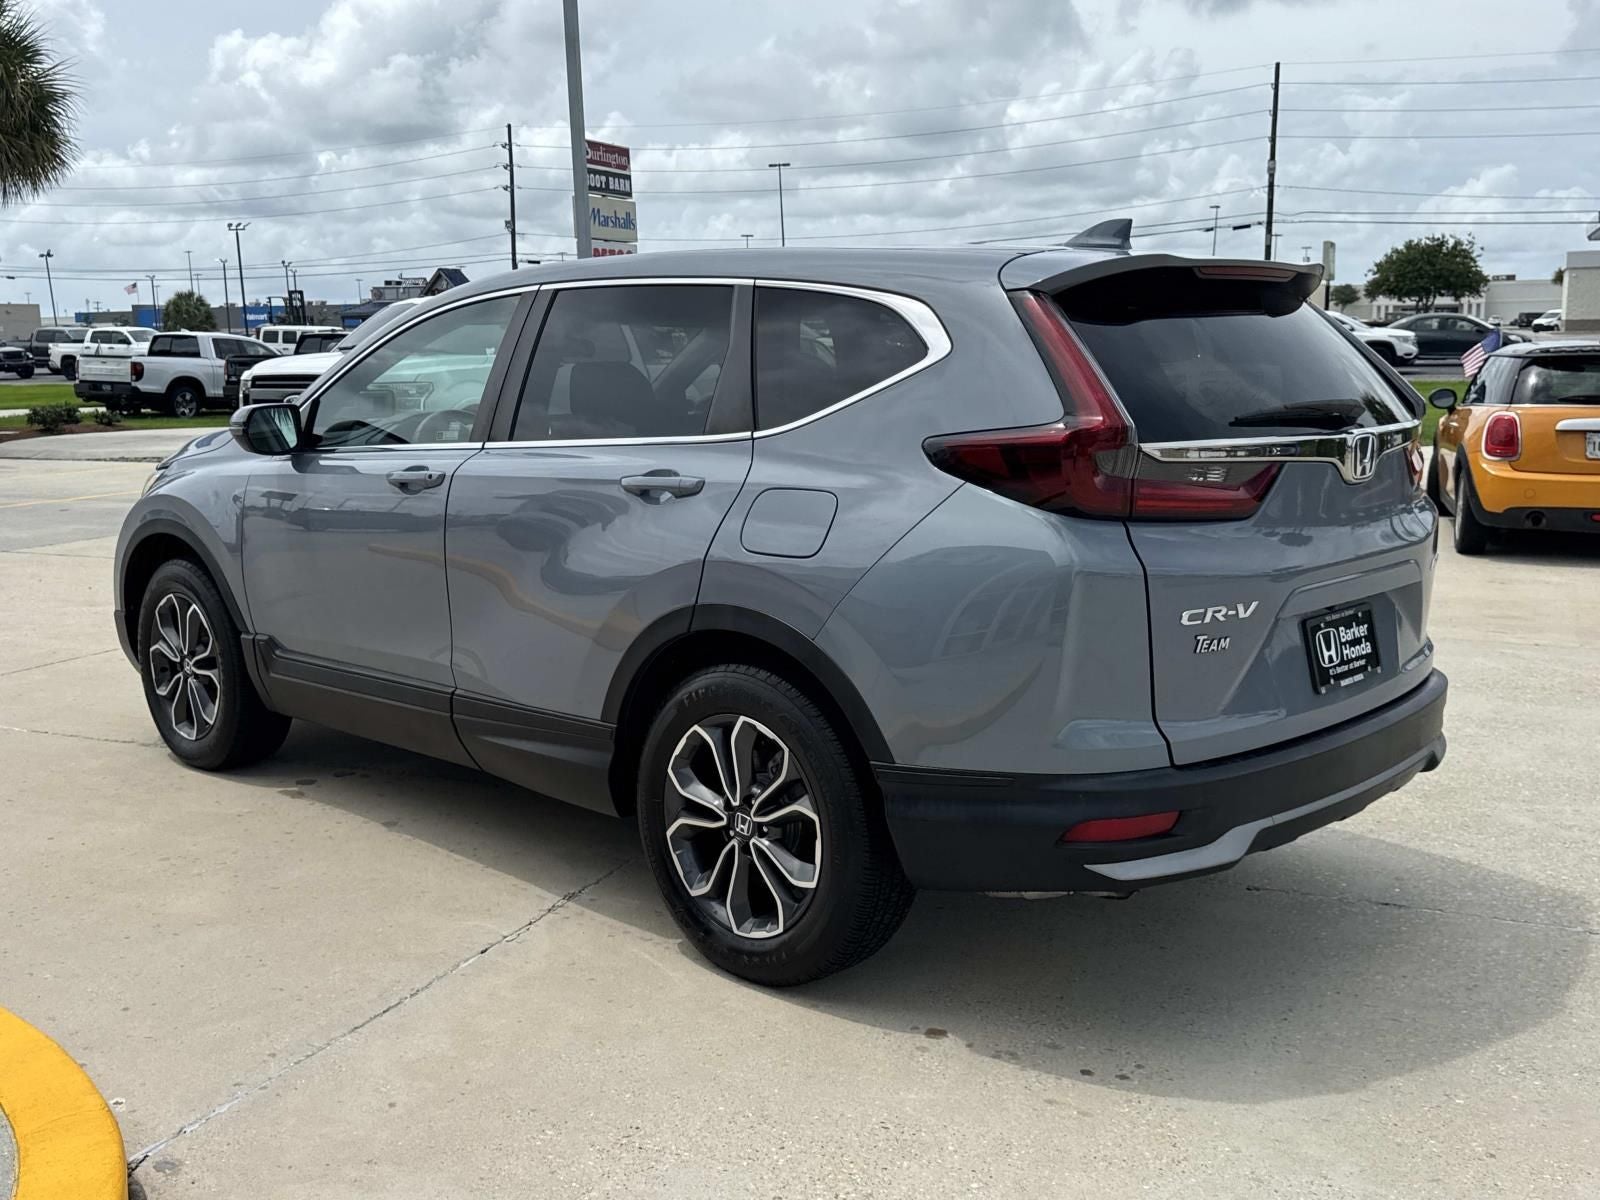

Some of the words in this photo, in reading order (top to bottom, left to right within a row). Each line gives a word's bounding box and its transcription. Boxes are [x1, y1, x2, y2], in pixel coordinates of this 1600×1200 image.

[587, 173, 607, 189] OOT
[609, 177, 631, 193] BARN
[591, 208, 636, 231] Marshalls
[1180, 600, 1260, 626] CR-V
[1339, 622, 1368, 642] Barker
[1342, 638, 1372, 660] Honda
